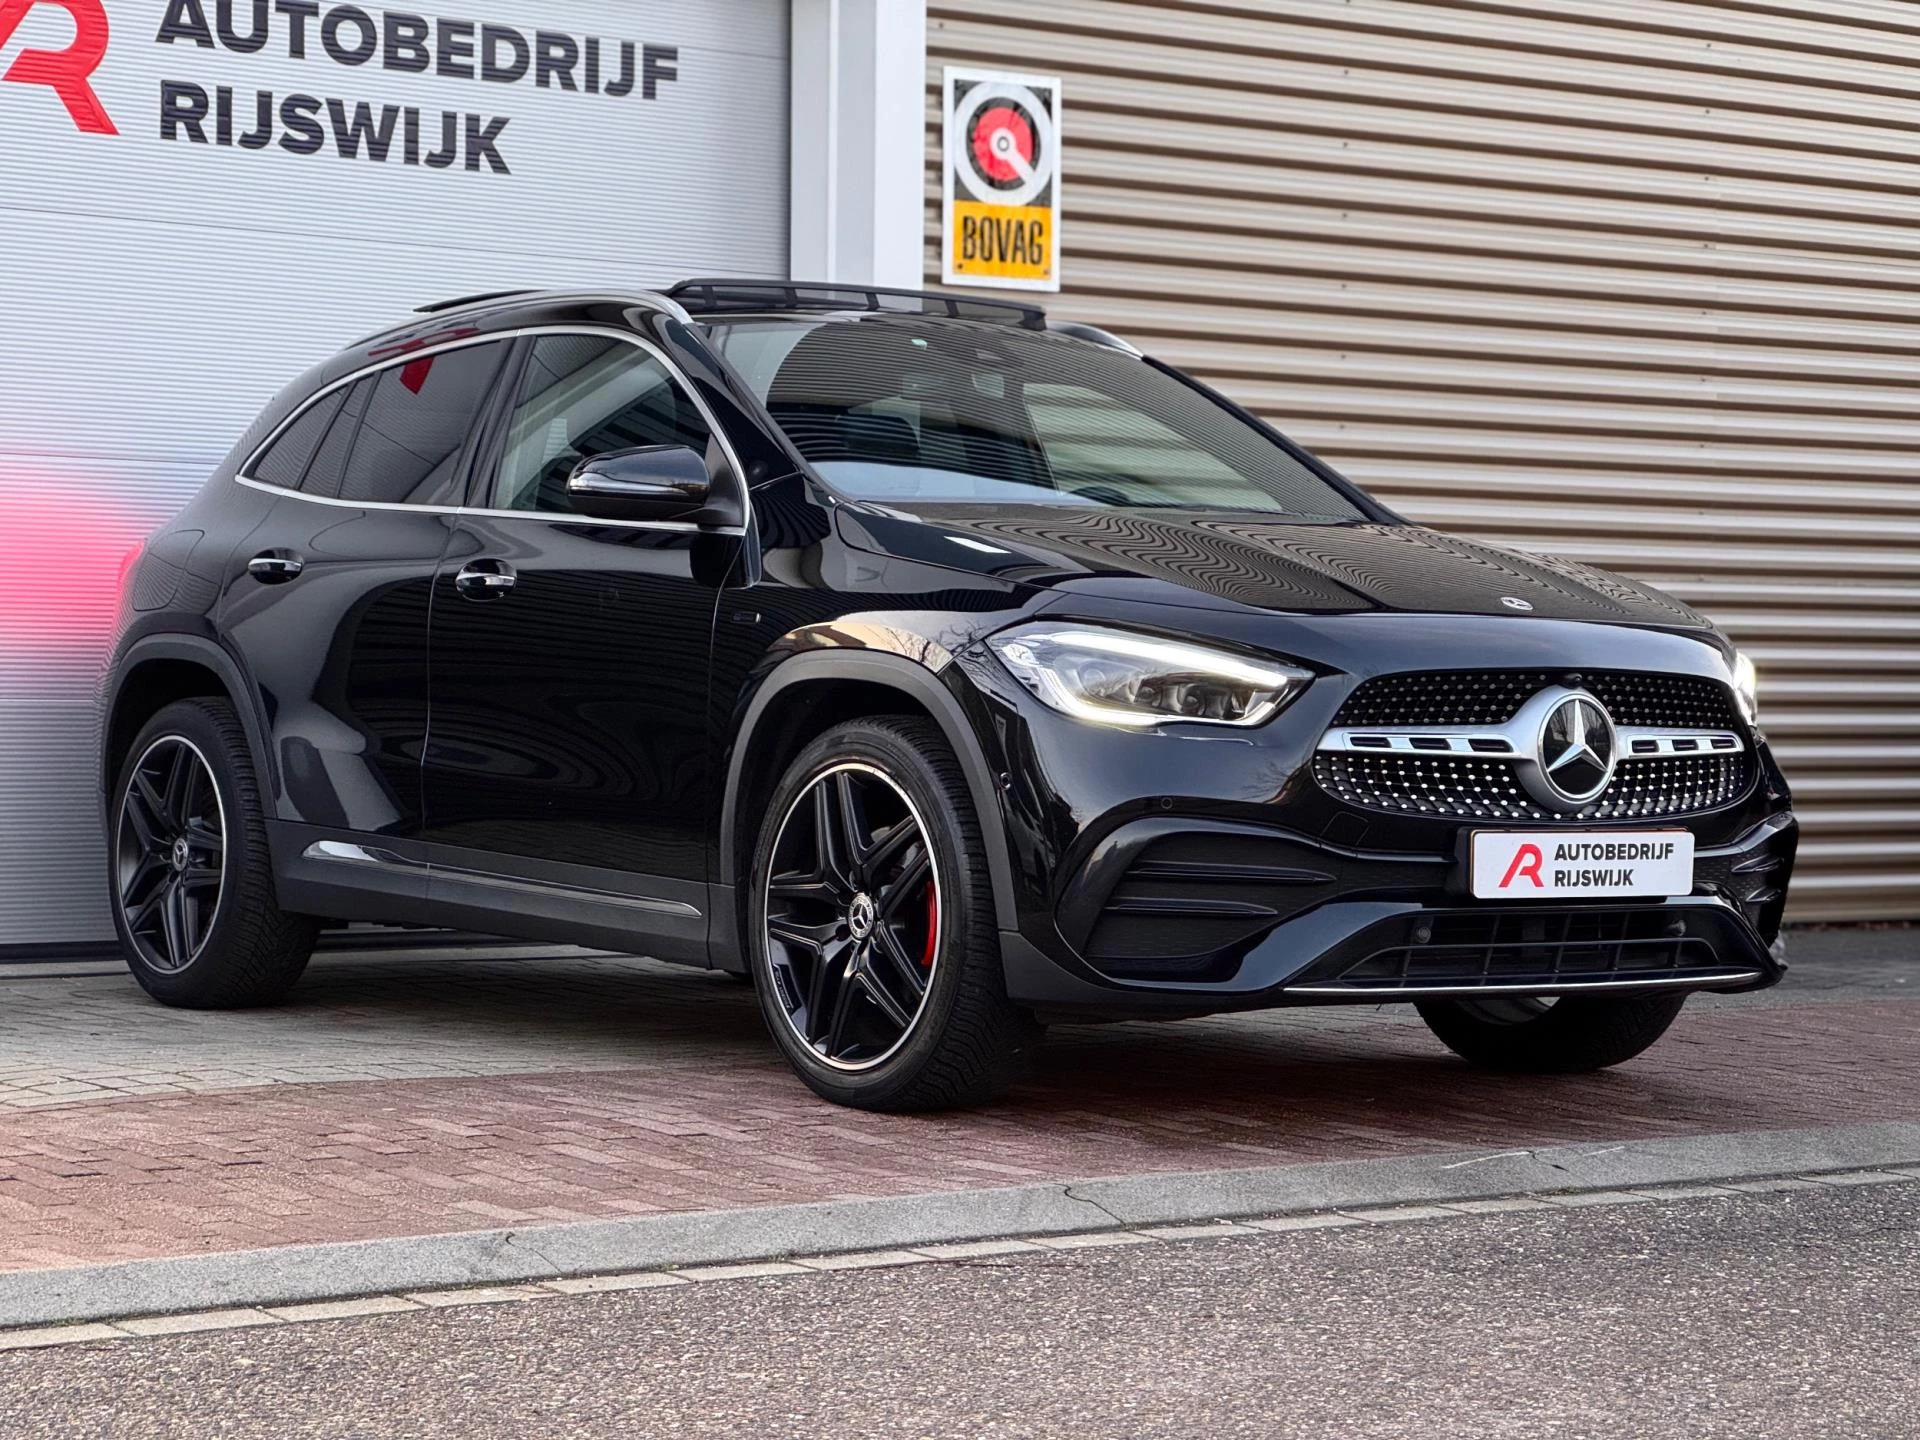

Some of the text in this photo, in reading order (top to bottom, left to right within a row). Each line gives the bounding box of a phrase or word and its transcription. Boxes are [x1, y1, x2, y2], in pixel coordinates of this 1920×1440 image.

[156, 0, 679, 99] AUTOBEDRIJF
[160, 80, 511, 174] RIJSWIJK
[962, 215, 1043, 265] BOVAG
[1554, 843, 1674, 860] AUTOBEDRIJF
[1554, 869, 1634, 887] RIJSWIJK
